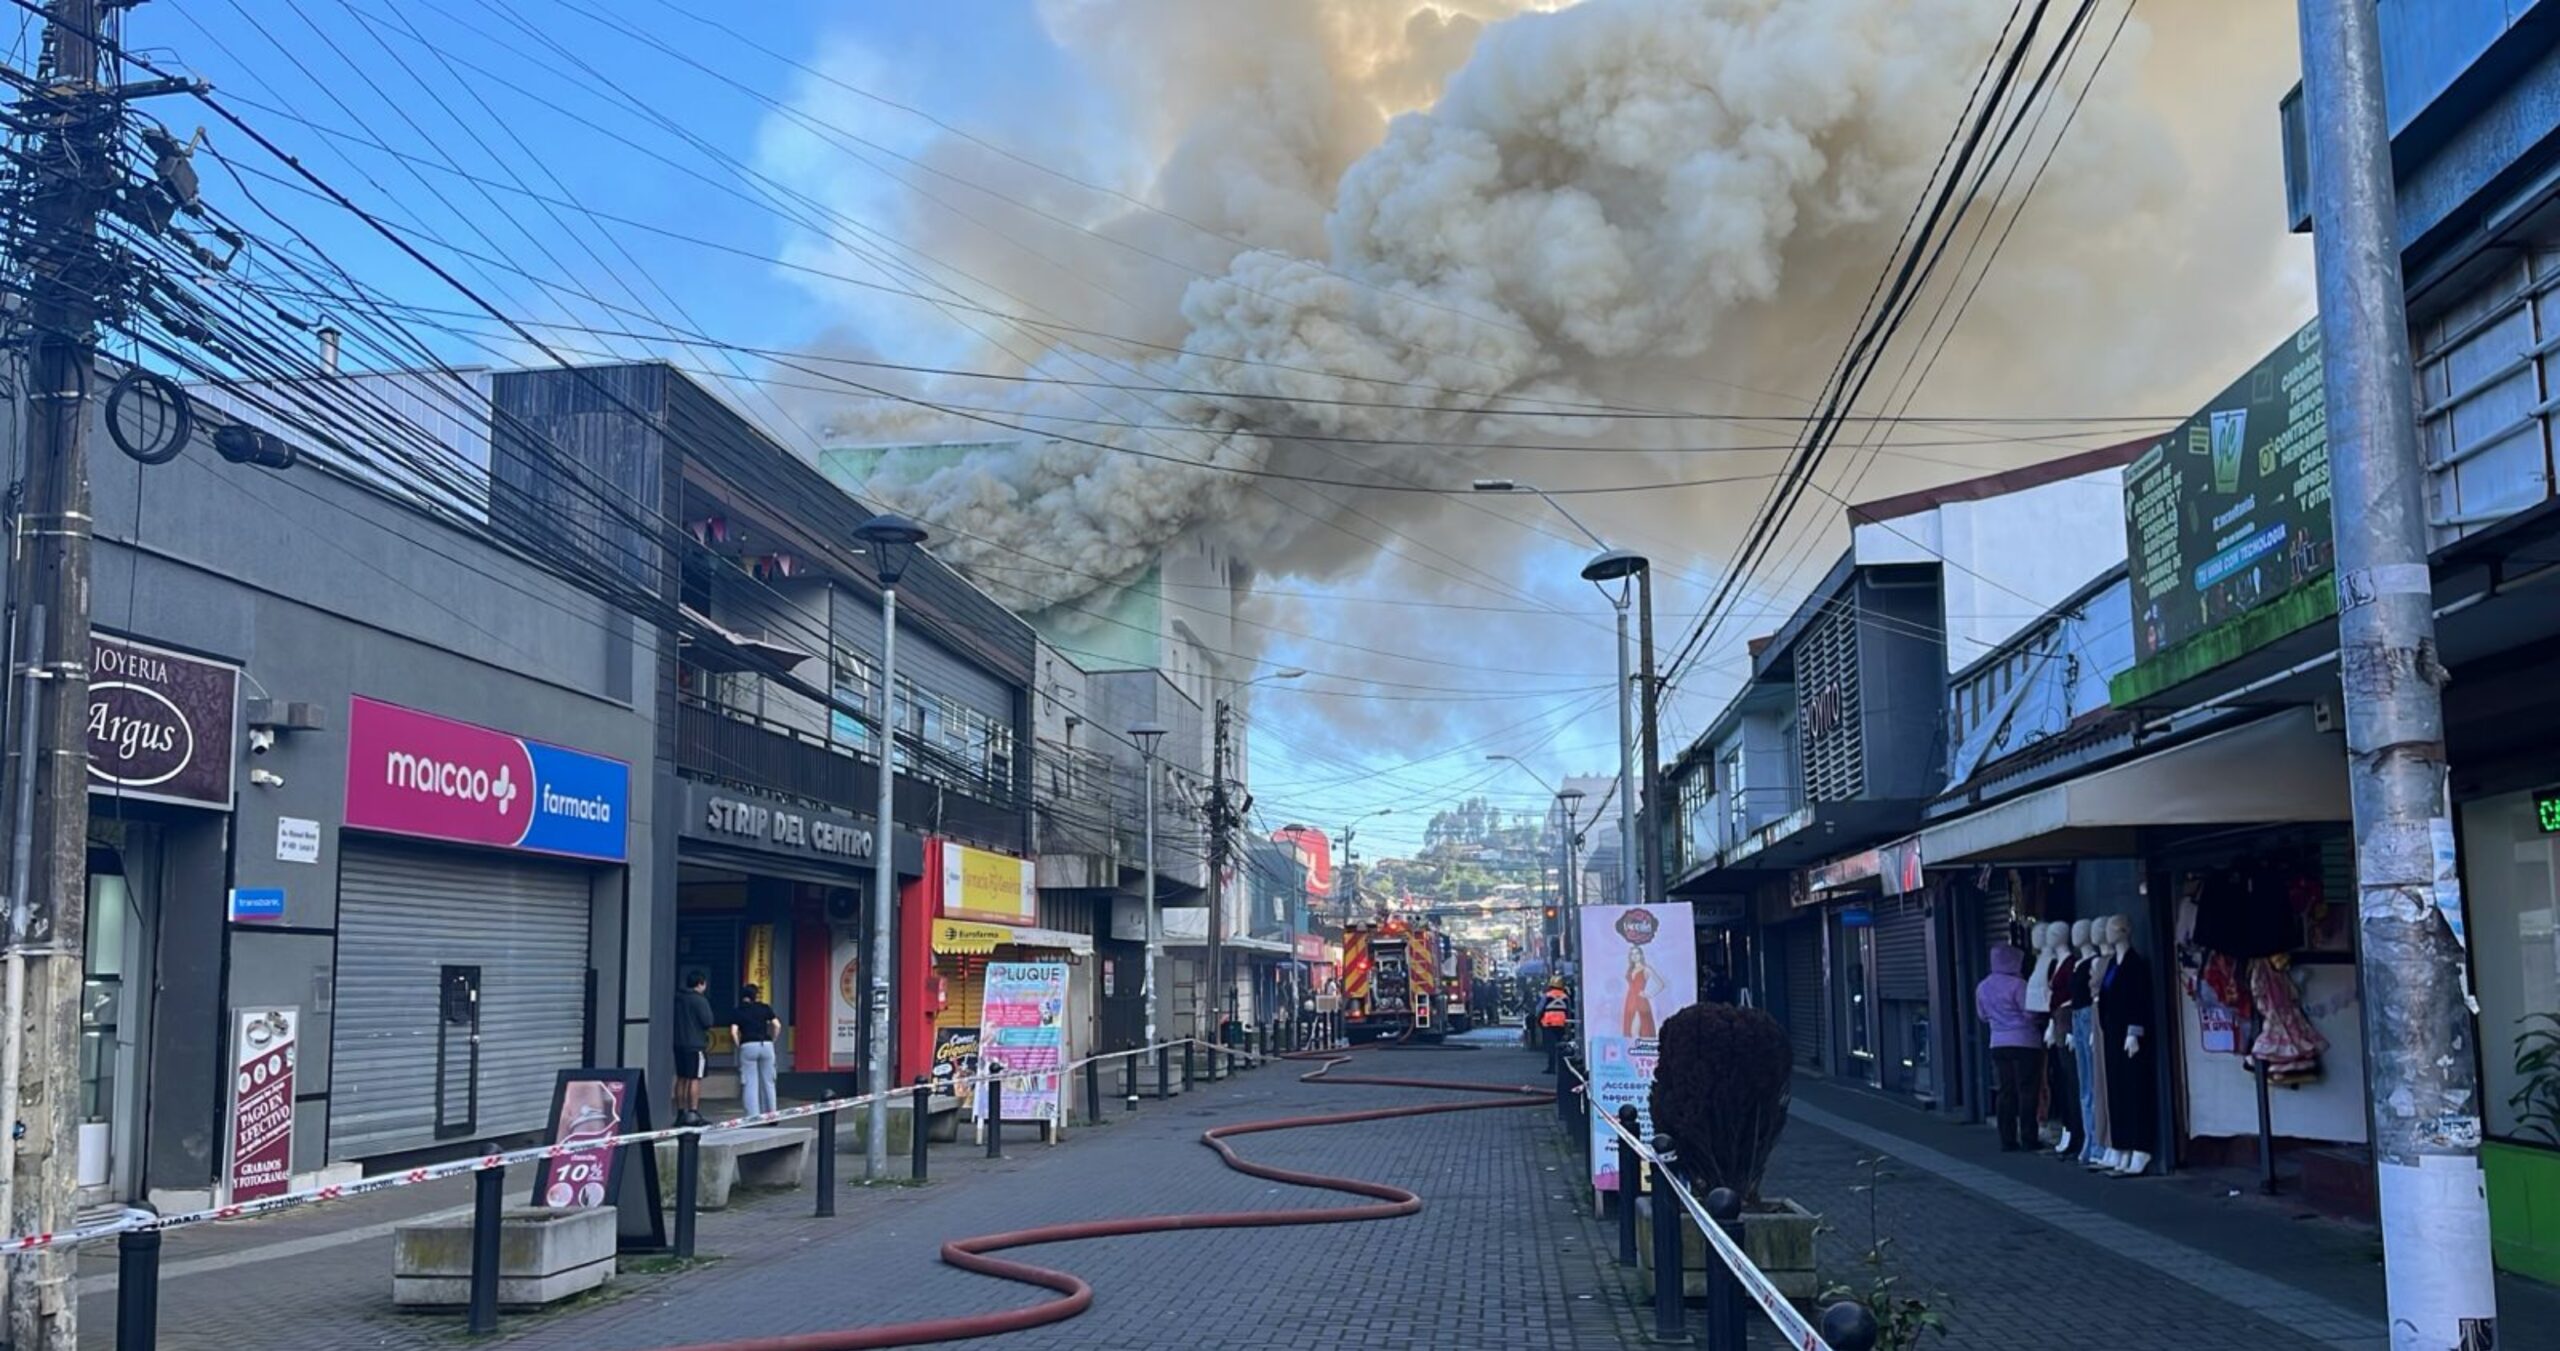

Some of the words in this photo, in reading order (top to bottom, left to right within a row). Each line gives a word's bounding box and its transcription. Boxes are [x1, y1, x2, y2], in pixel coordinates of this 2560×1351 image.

[2275, 405, 2327, 453] CONTROLES
[94, 647, 169, 685] JOYERIA
[87, 702, 176, 760] Argus
[386, 750, 490, 802] maicao
[542, 783, 611, 824] farmacia
[708, 796, 768, 838] STRIP
[772, 810, 806, 846] DEL
[810, 820, 874, 859] CENTRO
[239, 1105, 290, 1146] EFECTIVO
[240, 1102, 269, 1129] PAGO
[268, 1091, 284, 1111] EN
[241, 1159, 282, 1176] GRABADOS
[556, 1162, 603, 1181] 10%
